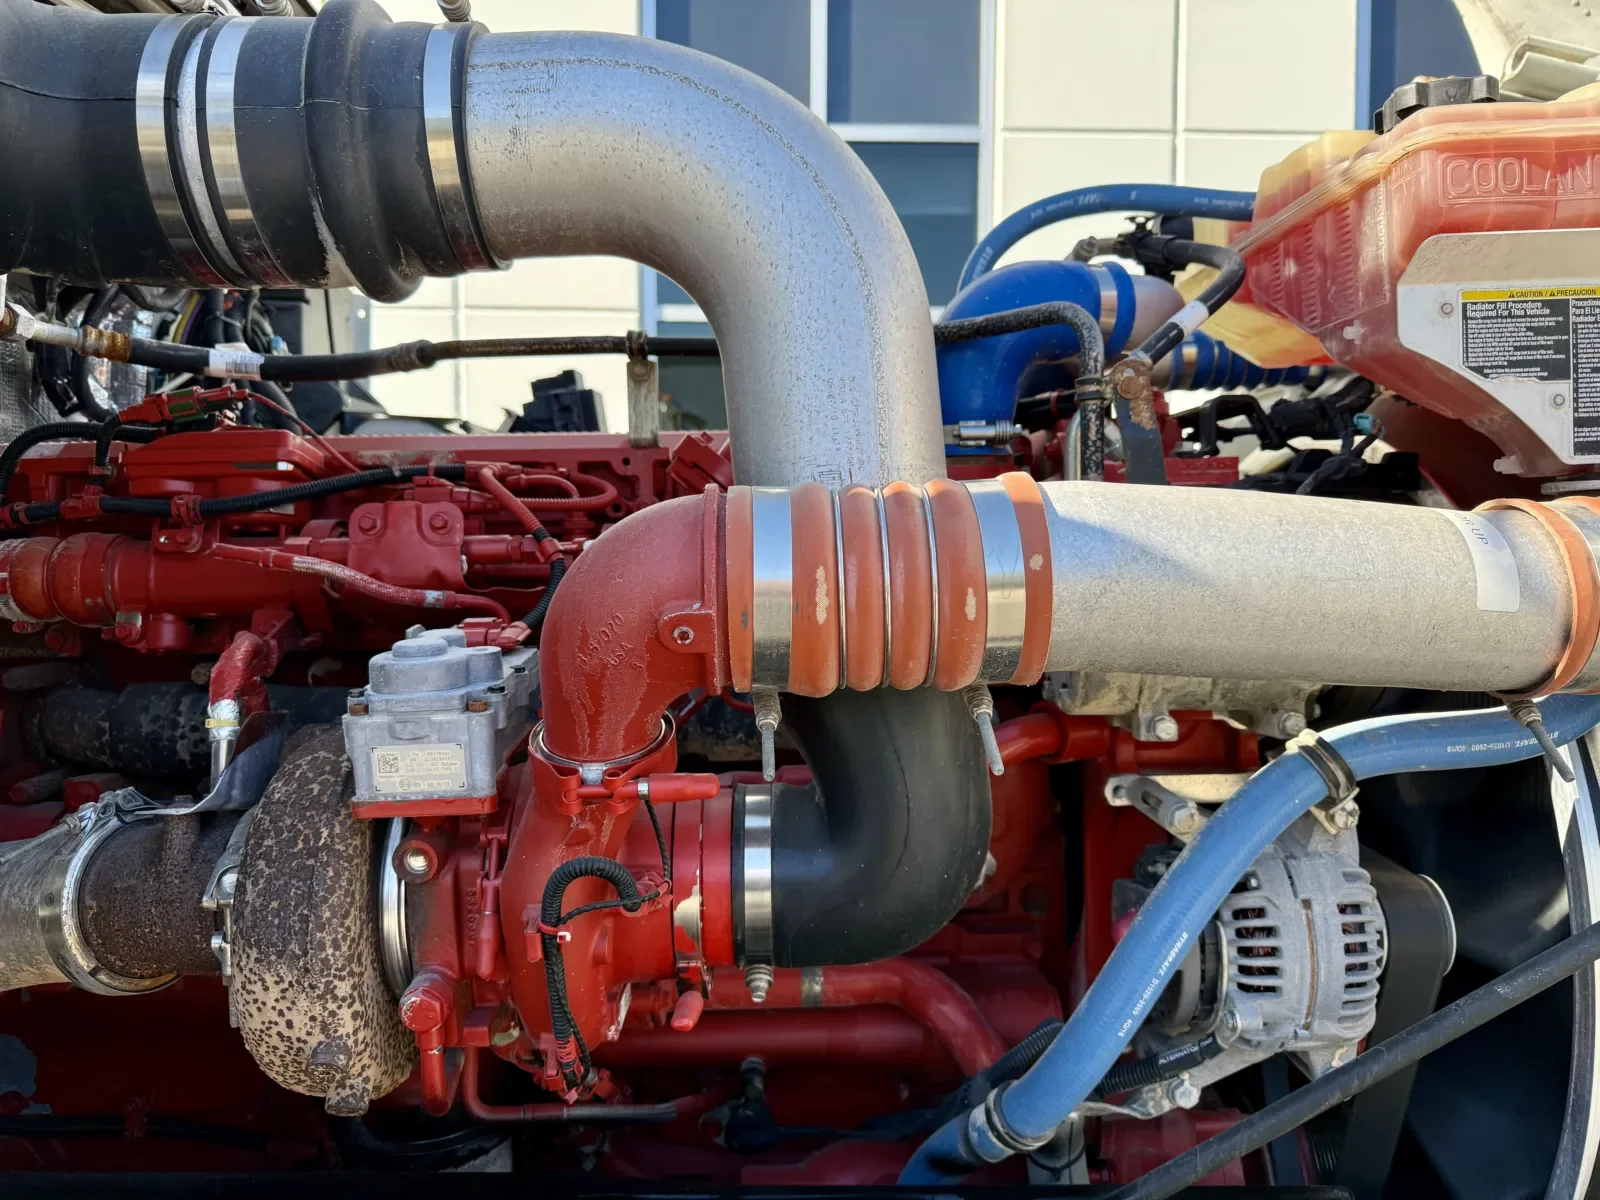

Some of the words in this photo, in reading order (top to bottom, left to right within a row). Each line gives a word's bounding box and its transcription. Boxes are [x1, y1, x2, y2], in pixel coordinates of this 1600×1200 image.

[1447, 155, 1600, 194] COOLAN
[1515, 290, 1543, 299] CAUTION
[1556, 288, 1596, 297] PRECAUCION
[1466, 302, 1495, 311] Radiator
[1496, 301, 1507, 310] Fill
[1508, 301, 1542, 310] Procedure
[1571, 307, 1584, 315] Para
[1466, 309, 1497, 319] Required
[1498, 309, 1509, 317] For
[1511, 308, 1525, 316] This
[1526, 306, 1550, 315] Vehicle
[1571, 314, 1596, 323] Radiador
[1471, 528, 1489, 545] UP
